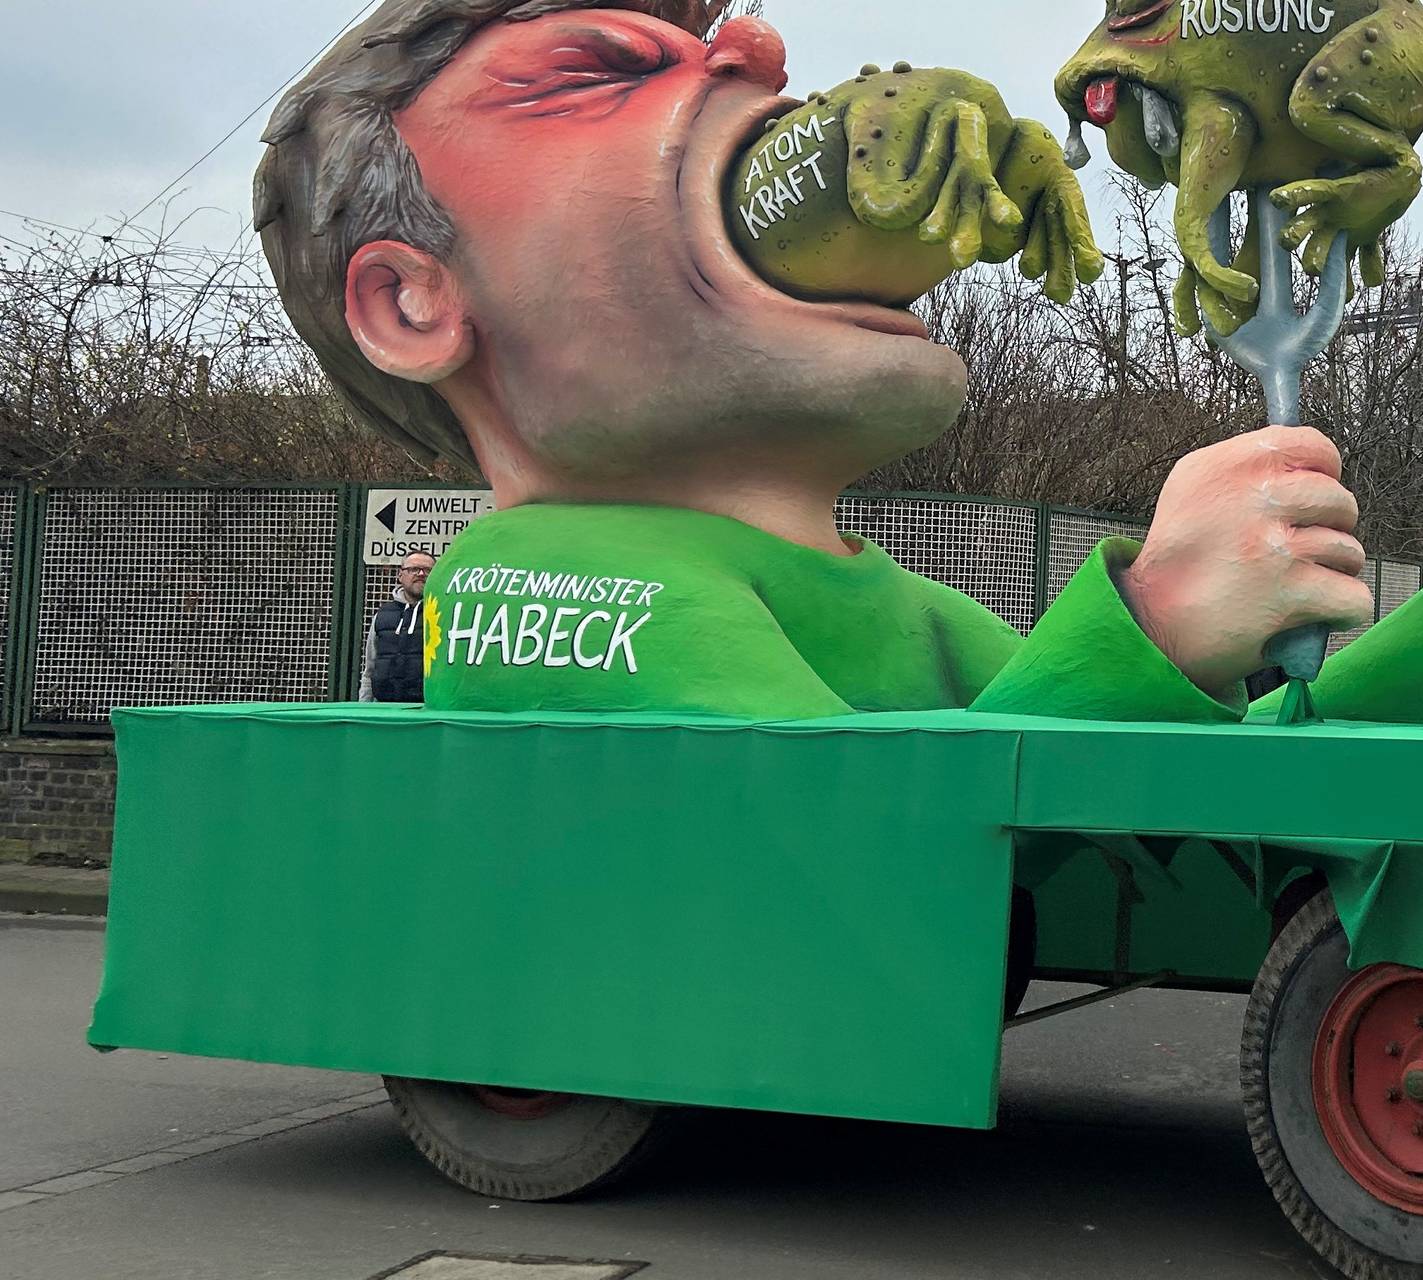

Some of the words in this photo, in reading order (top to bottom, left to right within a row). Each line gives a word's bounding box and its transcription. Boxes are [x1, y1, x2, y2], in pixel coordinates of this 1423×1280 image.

[744, 114, 836, 194] ATOM-
[739, 150, 827, 240] KRAFT
[404, 519, 469, 536] ZENTR
[406, 497, 481, 513] UMWELT
[445, 563, 665, 608] KRÖTENMINISTER
[447, 601, 652, 674] HABECK
